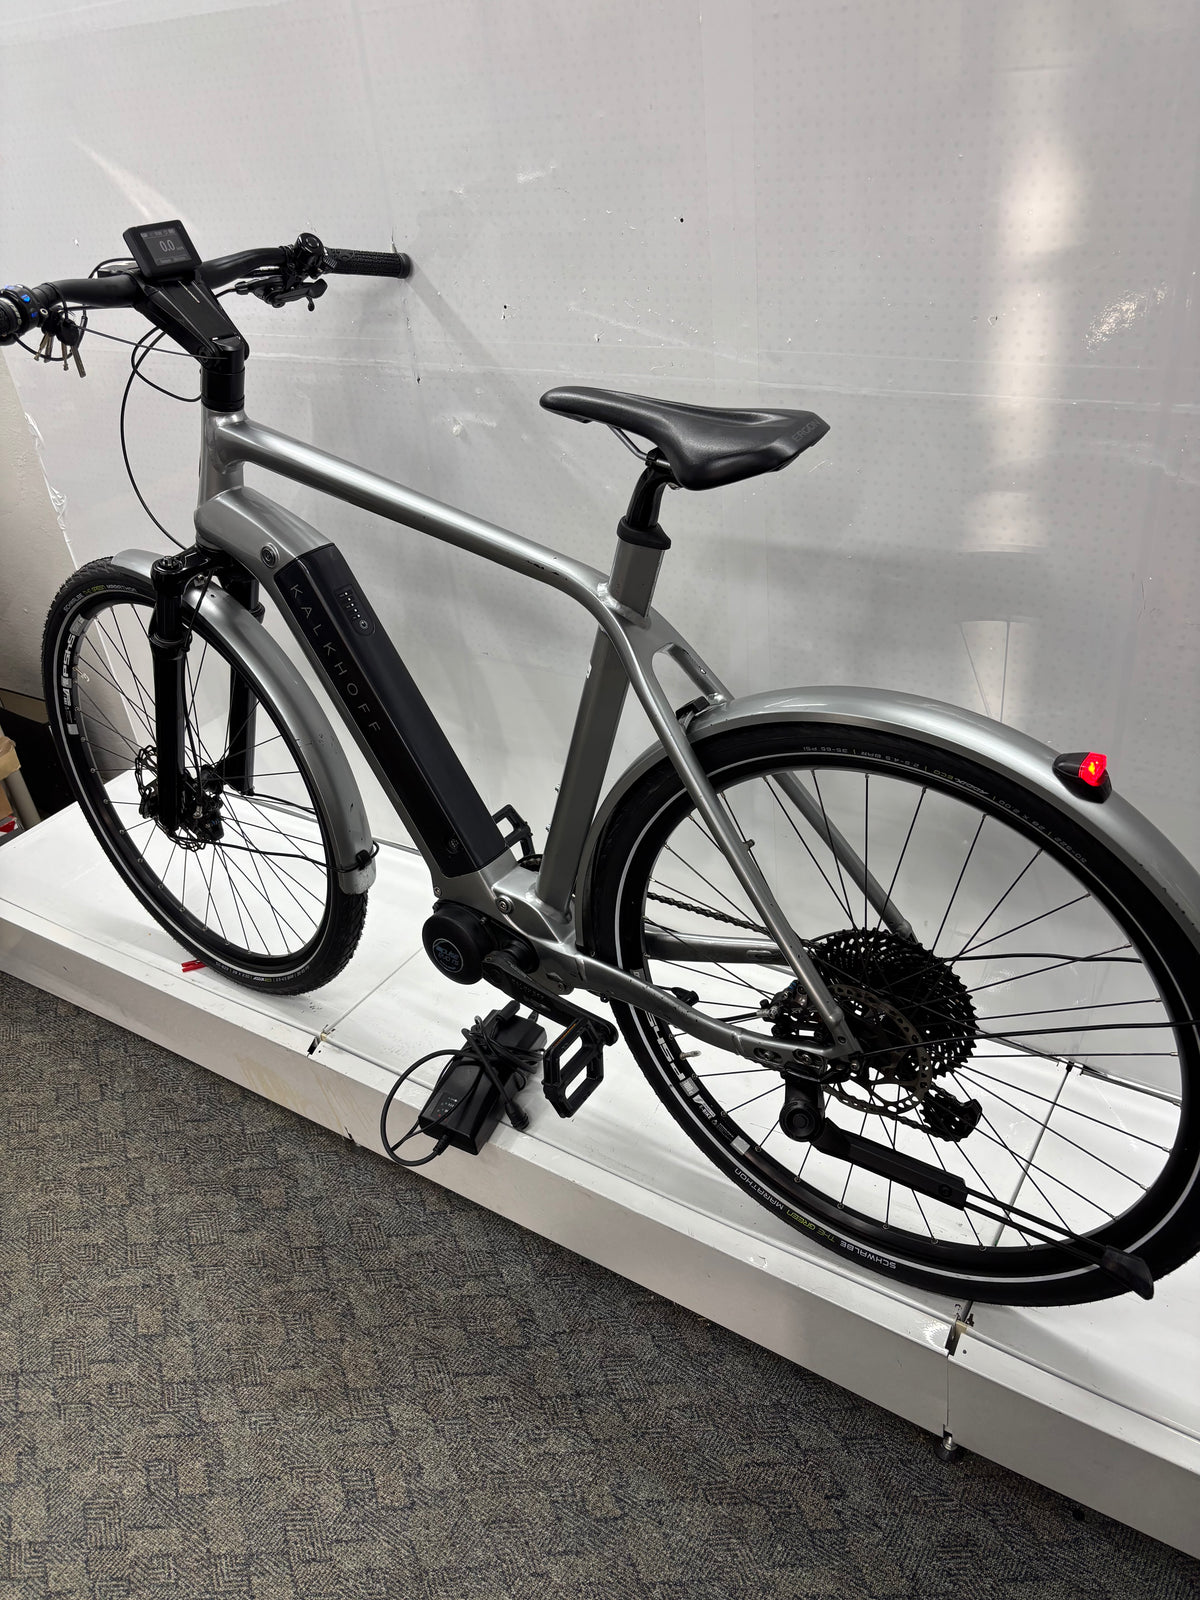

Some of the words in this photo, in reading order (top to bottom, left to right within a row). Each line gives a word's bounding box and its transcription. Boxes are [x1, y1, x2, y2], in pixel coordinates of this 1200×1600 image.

[159, 239, 176, 253] 0.0
[289, 583, 381, 734] KALKHOFF
[933, 768, 954, 780] ECO
[734, 1167, 784, 1211] MARATHON
[786, 1209, 816, 1231] GREEN
[816, 1229, 835, 1243] THE
[839, 1240, 897, 1270] SCHWALBE
